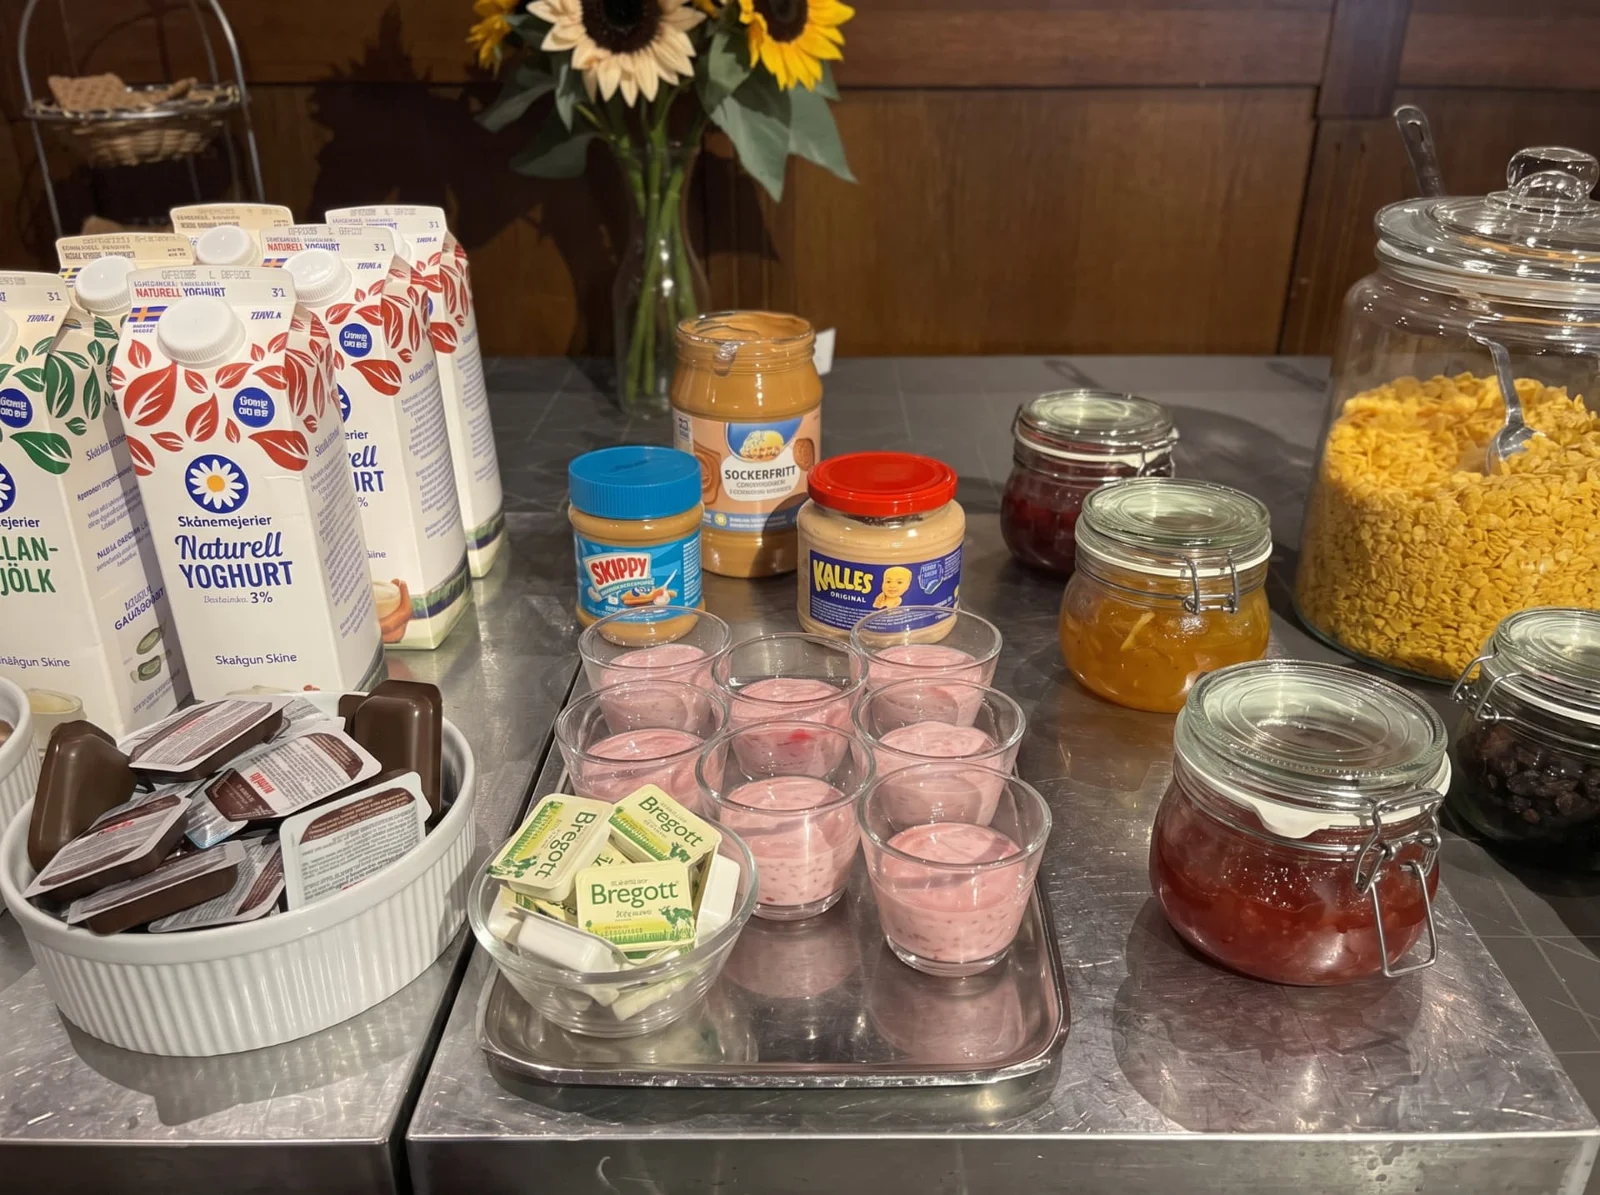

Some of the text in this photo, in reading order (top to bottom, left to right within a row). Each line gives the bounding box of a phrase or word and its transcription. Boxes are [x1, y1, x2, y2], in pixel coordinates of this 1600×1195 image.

[428, 221, 440, 229] 31
[267, 243, 303, 252] NATURELL
[374, 243, 387, 252] 31
[47, 292, 62, 301] 31
[135, 287, 182, 298] NATURELL
[271, 287, 287, 298] 31
[724, 465, 797, 481] SOCKERFRITT
[177, 515, 272, 530] Skånemejerier
[174, 531, 284, 561] Naturell
[178, 561, 293, 589] YOGHURT
[590, 557, 648, 586] SKIPPY
[812, 559, 874, 594] KALLES
[249, 591, 273, 604] 3%
[830, 590, 867, 603] ORIGINAL
[265, 652, 297, 664] Skine
[638, 796, 704, 848] Bregott
[534, 811, 598, 880] Bregott
[591, 882, 679, 909] Bregott
